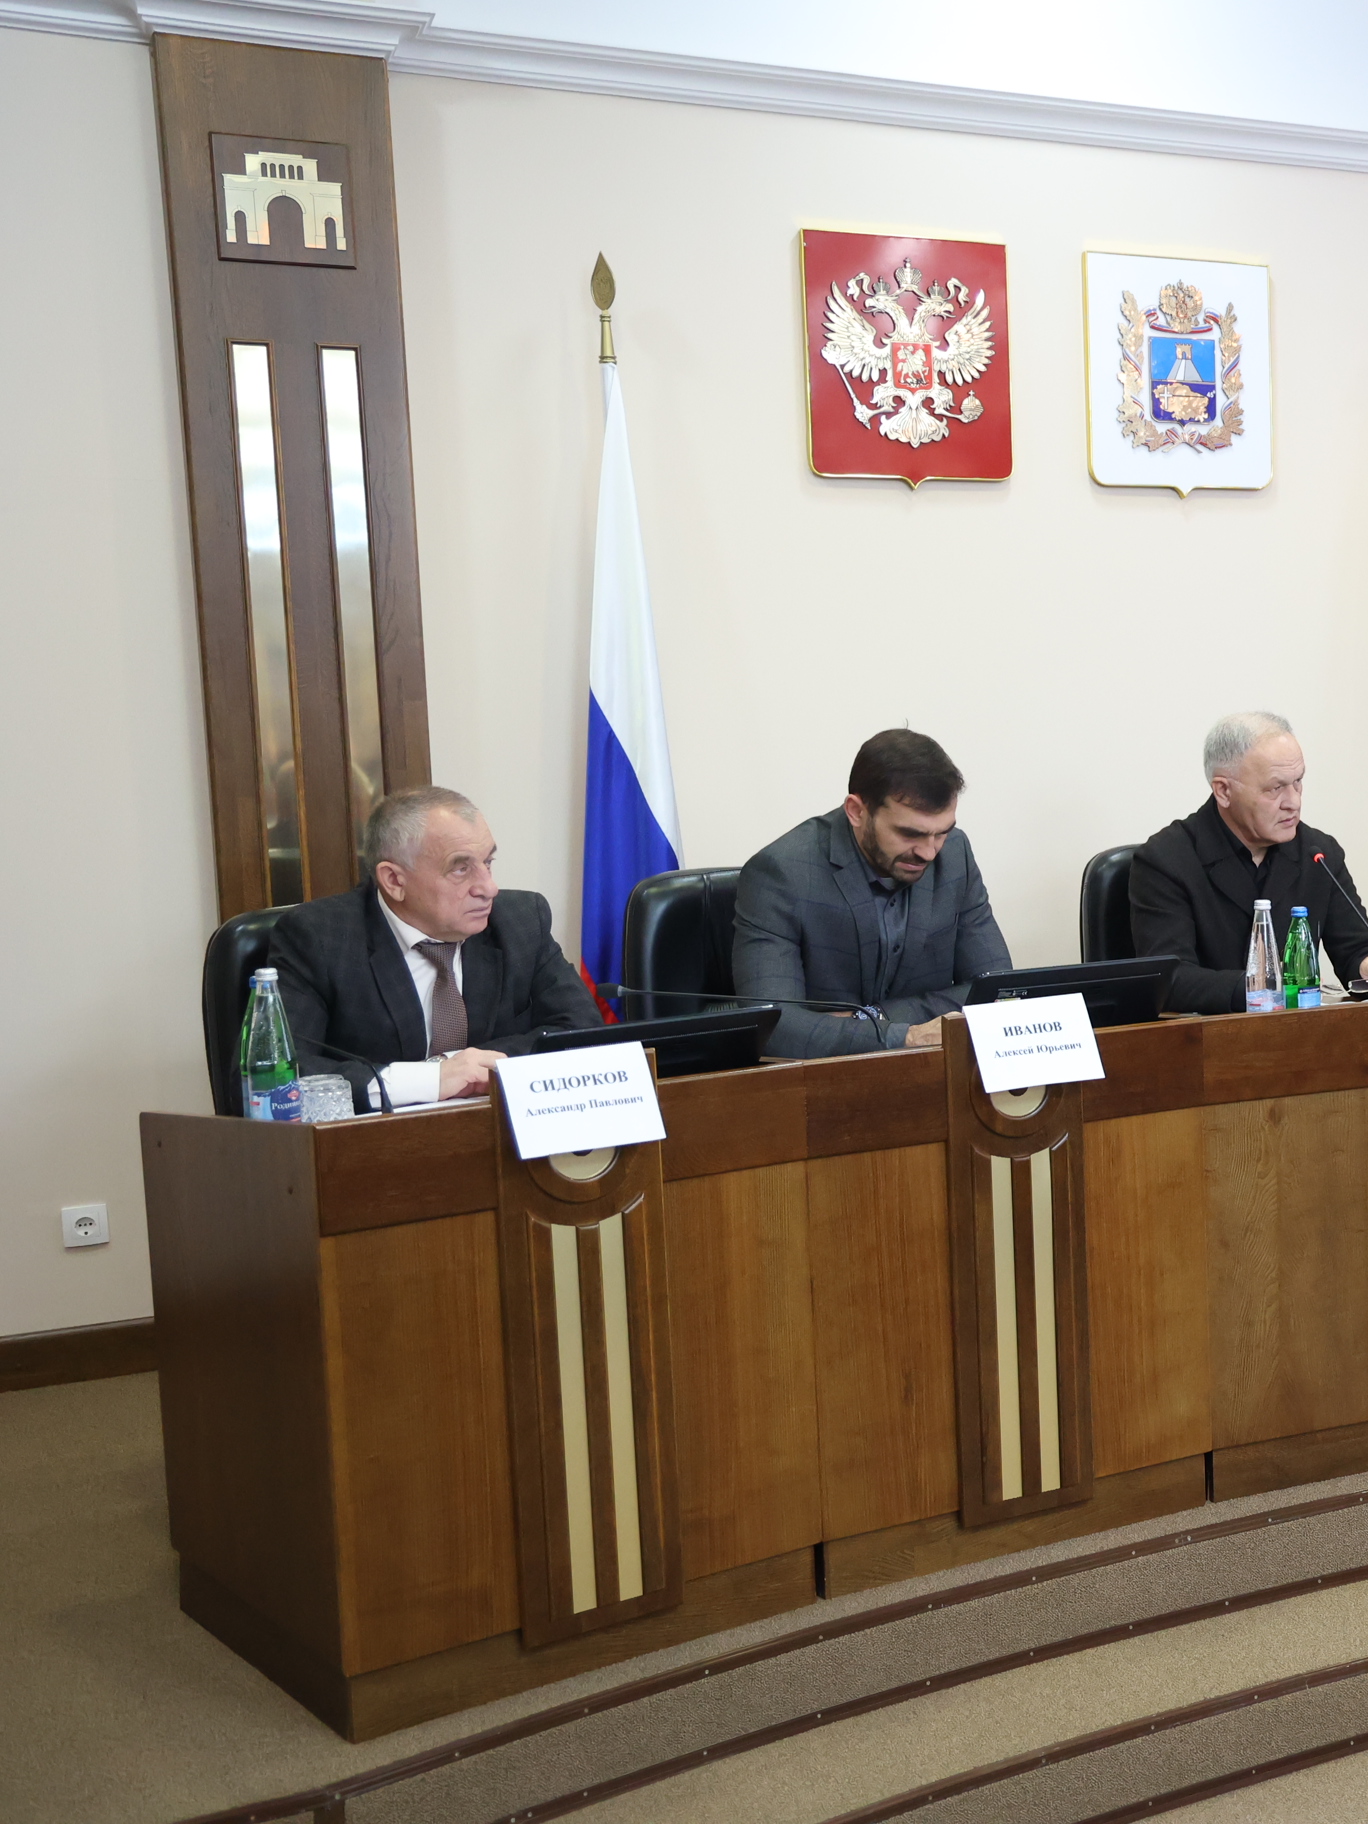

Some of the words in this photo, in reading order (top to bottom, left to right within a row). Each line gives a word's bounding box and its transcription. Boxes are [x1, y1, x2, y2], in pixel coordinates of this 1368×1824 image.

[1003, 1021, 1063, 1037] ИВАНОВ
[994, 1046, 1034, 1058] Алексей
[1036, 1042, 1082, 1055] Юрьевич
[529, 1070, 629, 1093] СИДОРКОВ
[525, 1101, 587, 1117] Александр
[589, 1095, 644, 1109] Павлович
